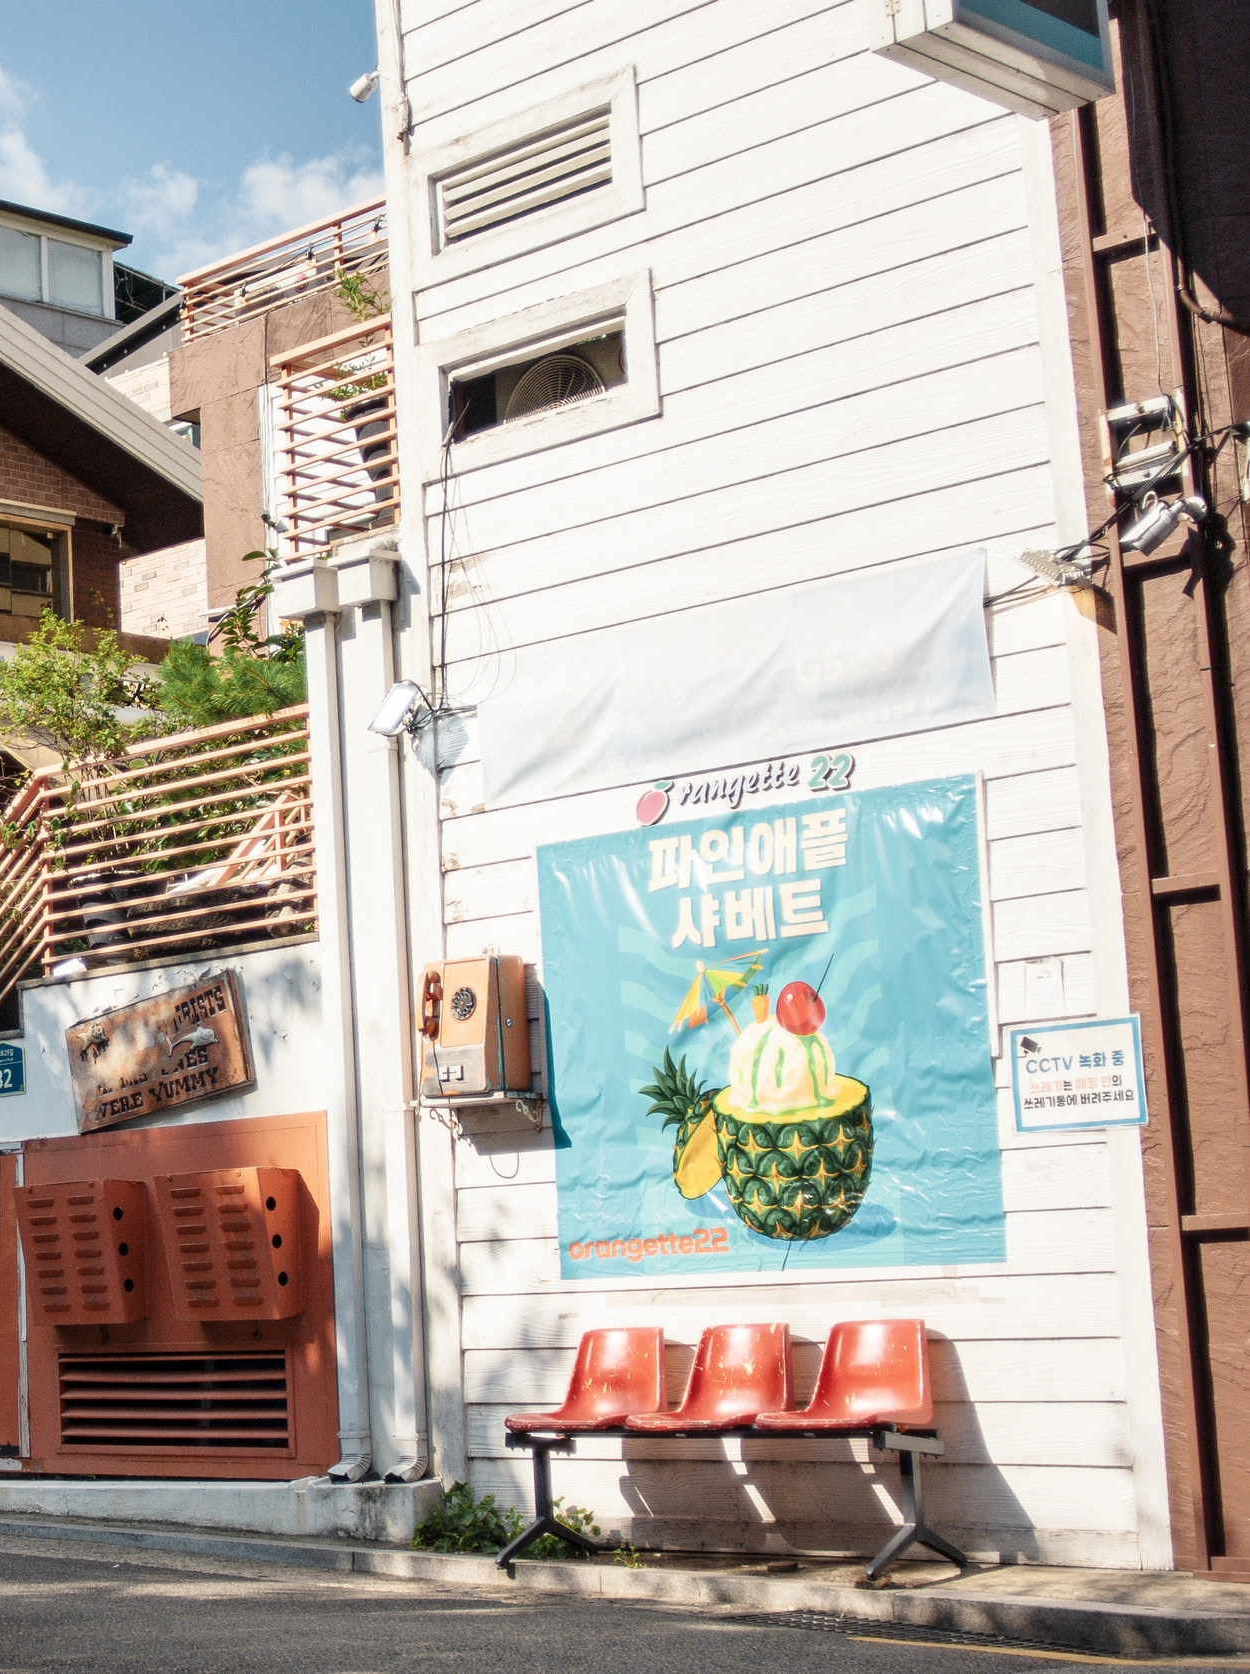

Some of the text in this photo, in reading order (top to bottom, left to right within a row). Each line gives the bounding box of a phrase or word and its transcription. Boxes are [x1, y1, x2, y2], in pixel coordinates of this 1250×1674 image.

[807, 752, 856, 793] 22
[648, 807, 849, 893] 파인애플
[671, 878, 830, 949] 샤베트
[1025, 1050, 1124, 1074] CCTV 녹화 중
[148, 1064, 219, 1103] YUMMY
[1023, 1089, 1135, 1110] 쓰레기통에 버려주세요
[1029, 1074, 1123, 1094] 쓰레기는 매장 안의
[568, 1227, 731, 1263] orangette22
